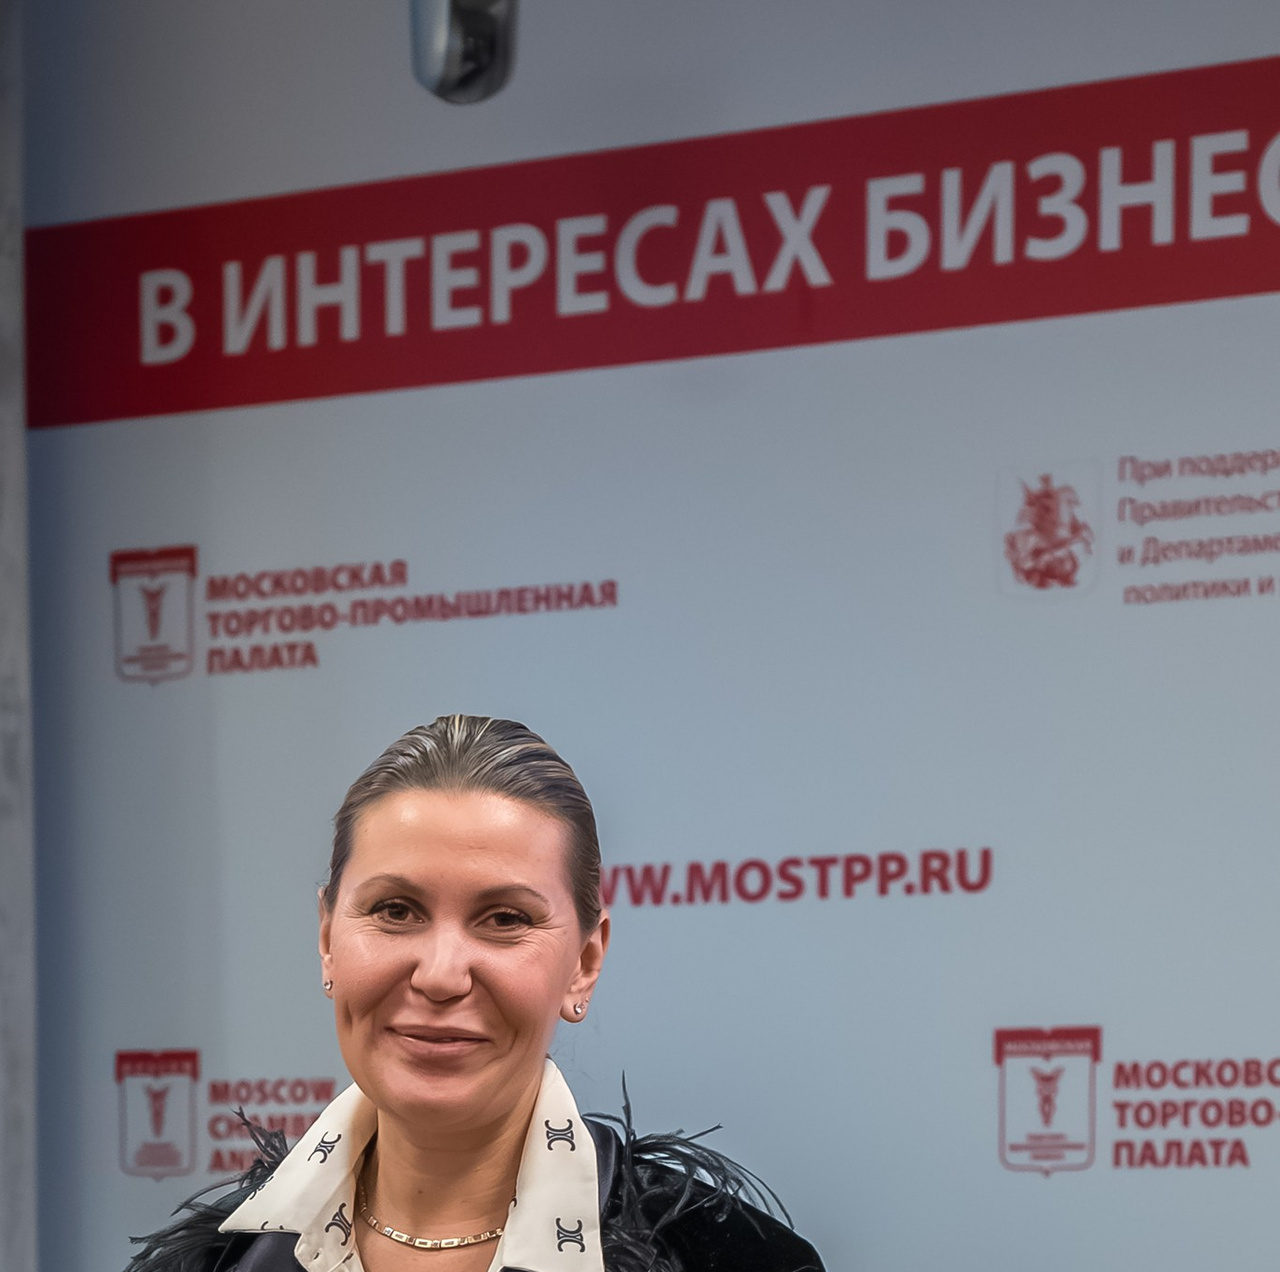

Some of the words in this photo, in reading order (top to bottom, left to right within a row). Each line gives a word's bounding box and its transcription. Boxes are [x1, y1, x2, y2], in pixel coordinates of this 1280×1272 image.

[138, 267, 196, 365] В
[222, 184, 834, 354] ИНТЕРЕСАХ
[1118, 455, 1172, 486] При
[207, 560, 409, 602] МОСКОВСКАЯ
[207, 580, 618, 639] ТОРГОВО-ПРОМЫШЛЕННАЯ
[207, 641, 319, 675] ПАЛАТА
[208, 1078, 336, 1105] MOSCOW
[1113, 1138, 1250, 1168] ПАЛАТА
